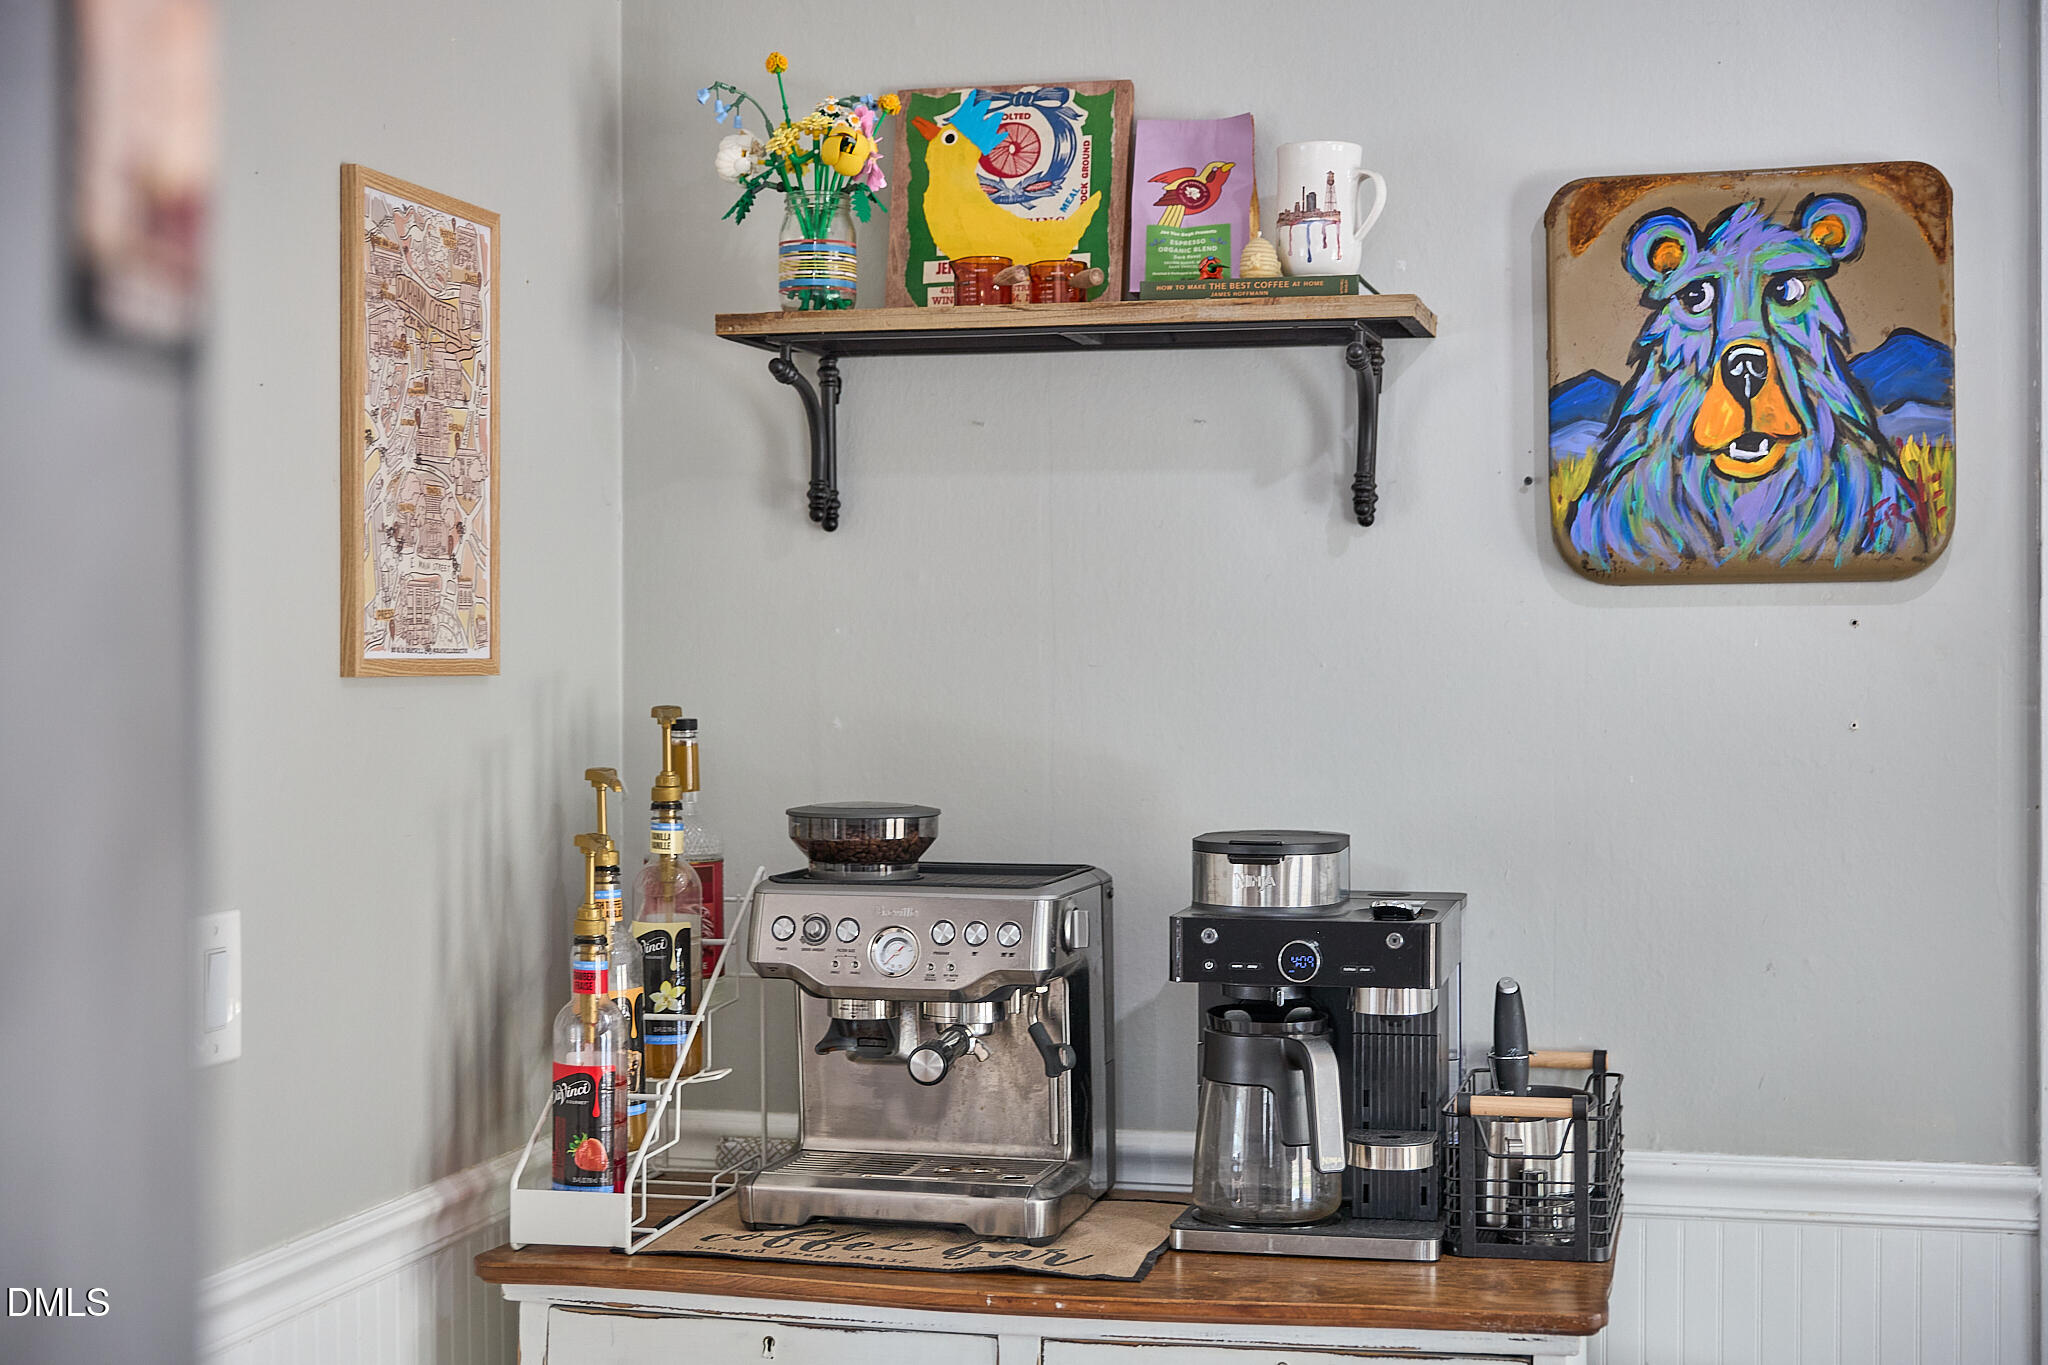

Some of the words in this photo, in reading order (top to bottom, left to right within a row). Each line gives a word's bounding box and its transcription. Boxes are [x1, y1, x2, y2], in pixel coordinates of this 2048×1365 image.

[1001, 112, 1031, 121] OLTED
[1081, 140, 1090, 178] GROUND
[1059, 187, 1080, 213] MEAL
[1080, 182, 1089, 205] OCK
[1170, 238, 1206, 246] ESPRESSO
[1193, 245, 1218, 253] BLEND
[1208, 282, 1227, 290] THE
[1229, 281, 1252, 290] BEST
[1254, 280, 1290, 289] COFFEE
[396, 277, 427, 320] DURHAM
[429, 299, 457, 337] COFFEE
[931, 296, 954, 305] WIN
[1234, 873, 1276, 893] NINJA
[700, 1228, 933, 1252] coffee
[942, 1237, 1094, 1266] bar
